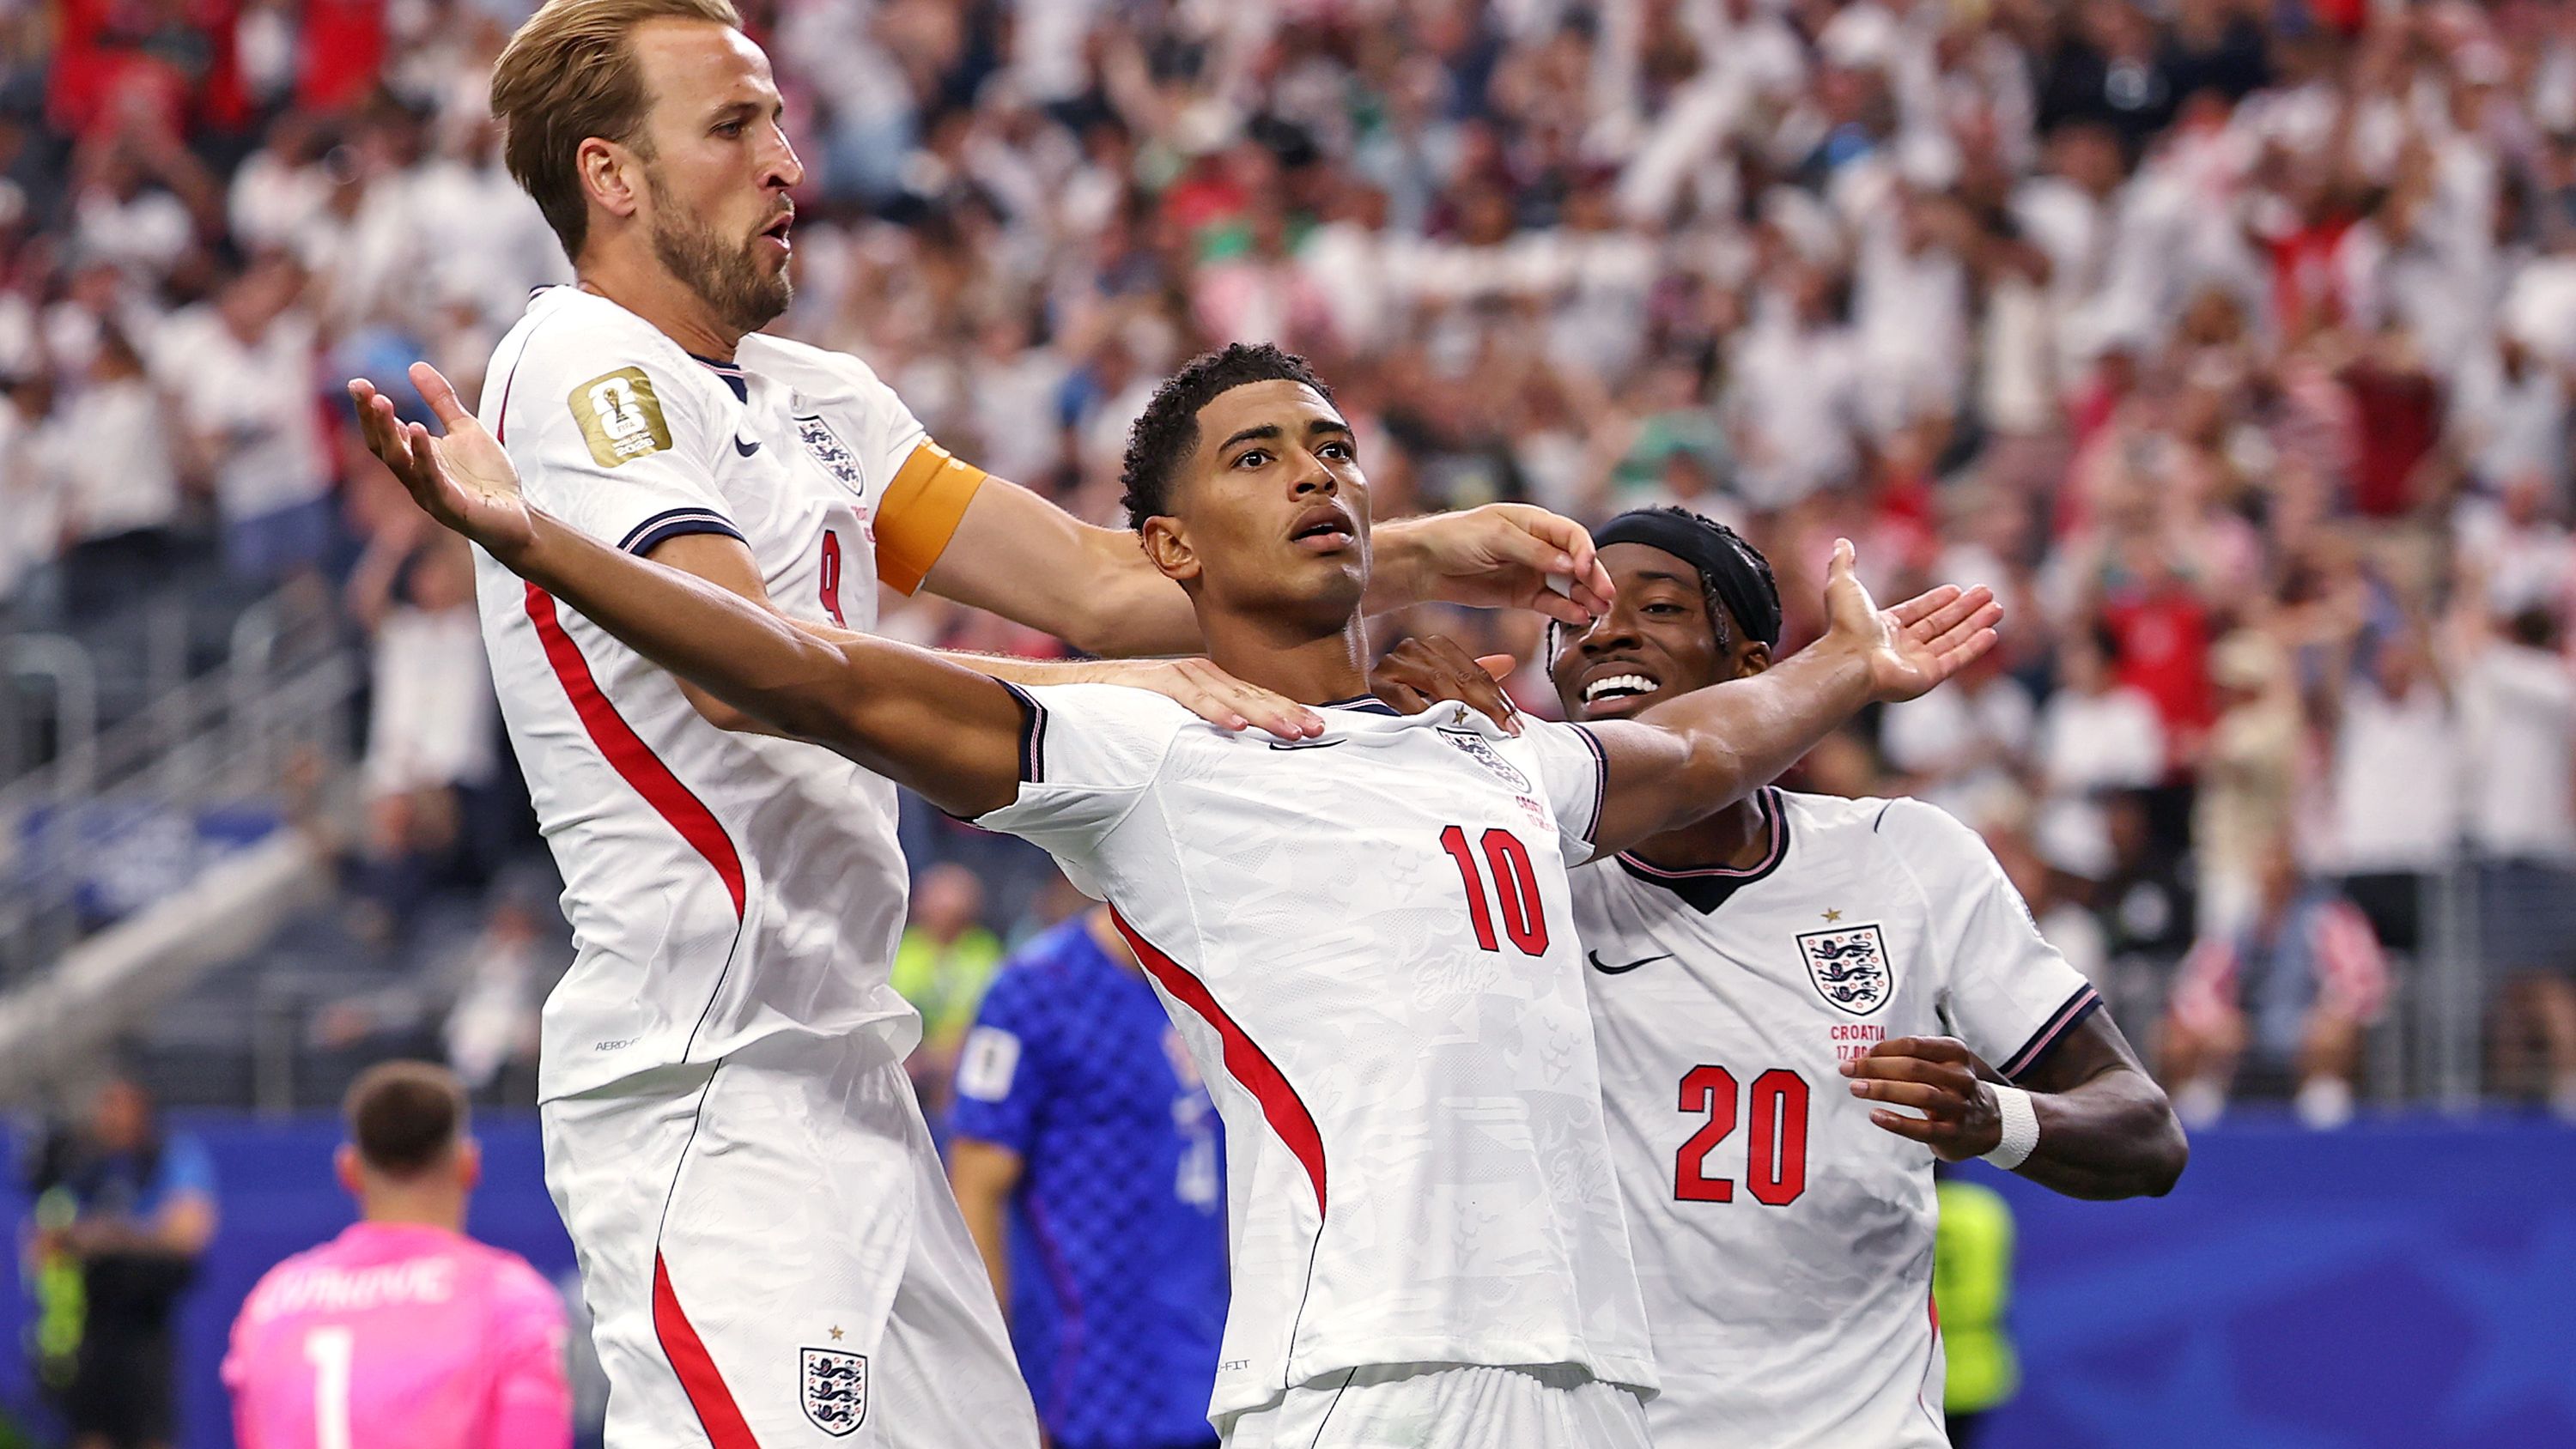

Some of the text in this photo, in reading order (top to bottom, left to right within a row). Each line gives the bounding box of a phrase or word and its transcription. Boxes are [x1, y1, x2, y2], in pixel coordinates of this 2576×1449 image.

[820, 530, 847, 628] 9
[1439, 825, 1549, 957] 10
[1831, 1024, 1886, 1041] CROATIA
[1674, 1064, 1809, 1206] 20
[303, 1325, 352, 1449] 1
